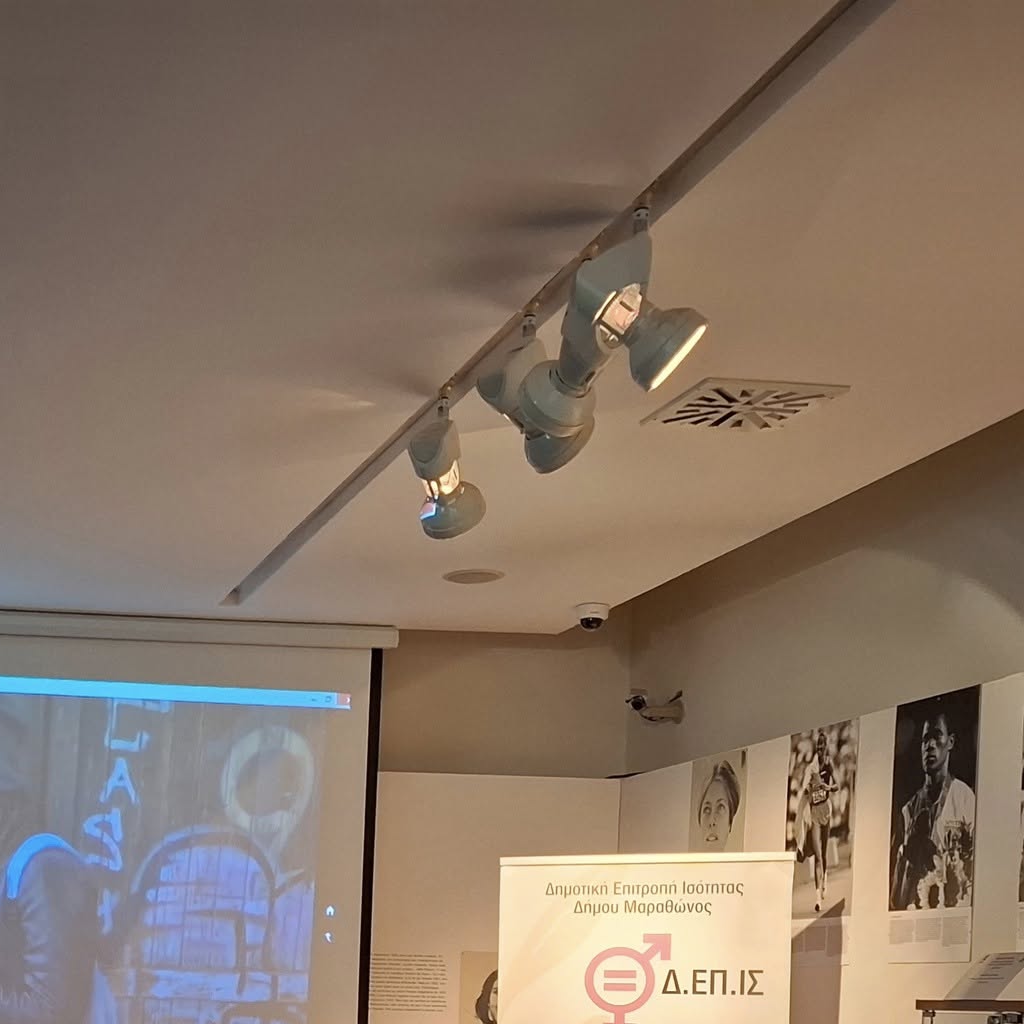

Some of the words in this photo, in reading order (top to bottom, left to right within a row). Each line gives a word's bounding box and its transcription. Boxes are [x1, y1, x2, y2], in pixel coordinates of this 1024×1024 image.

[545, 881, 608, 898] Δημοτική
[613, 881, 677, 898] Επιτροπή
[682, 880, 744, 896] Ισότητας
[573, 900, 619, 916] Δήμου
[624, 899, 712, 916] Μαραθώνος
[661, 969, 764, 995] Δ.ΕΠ.ΙΣ
